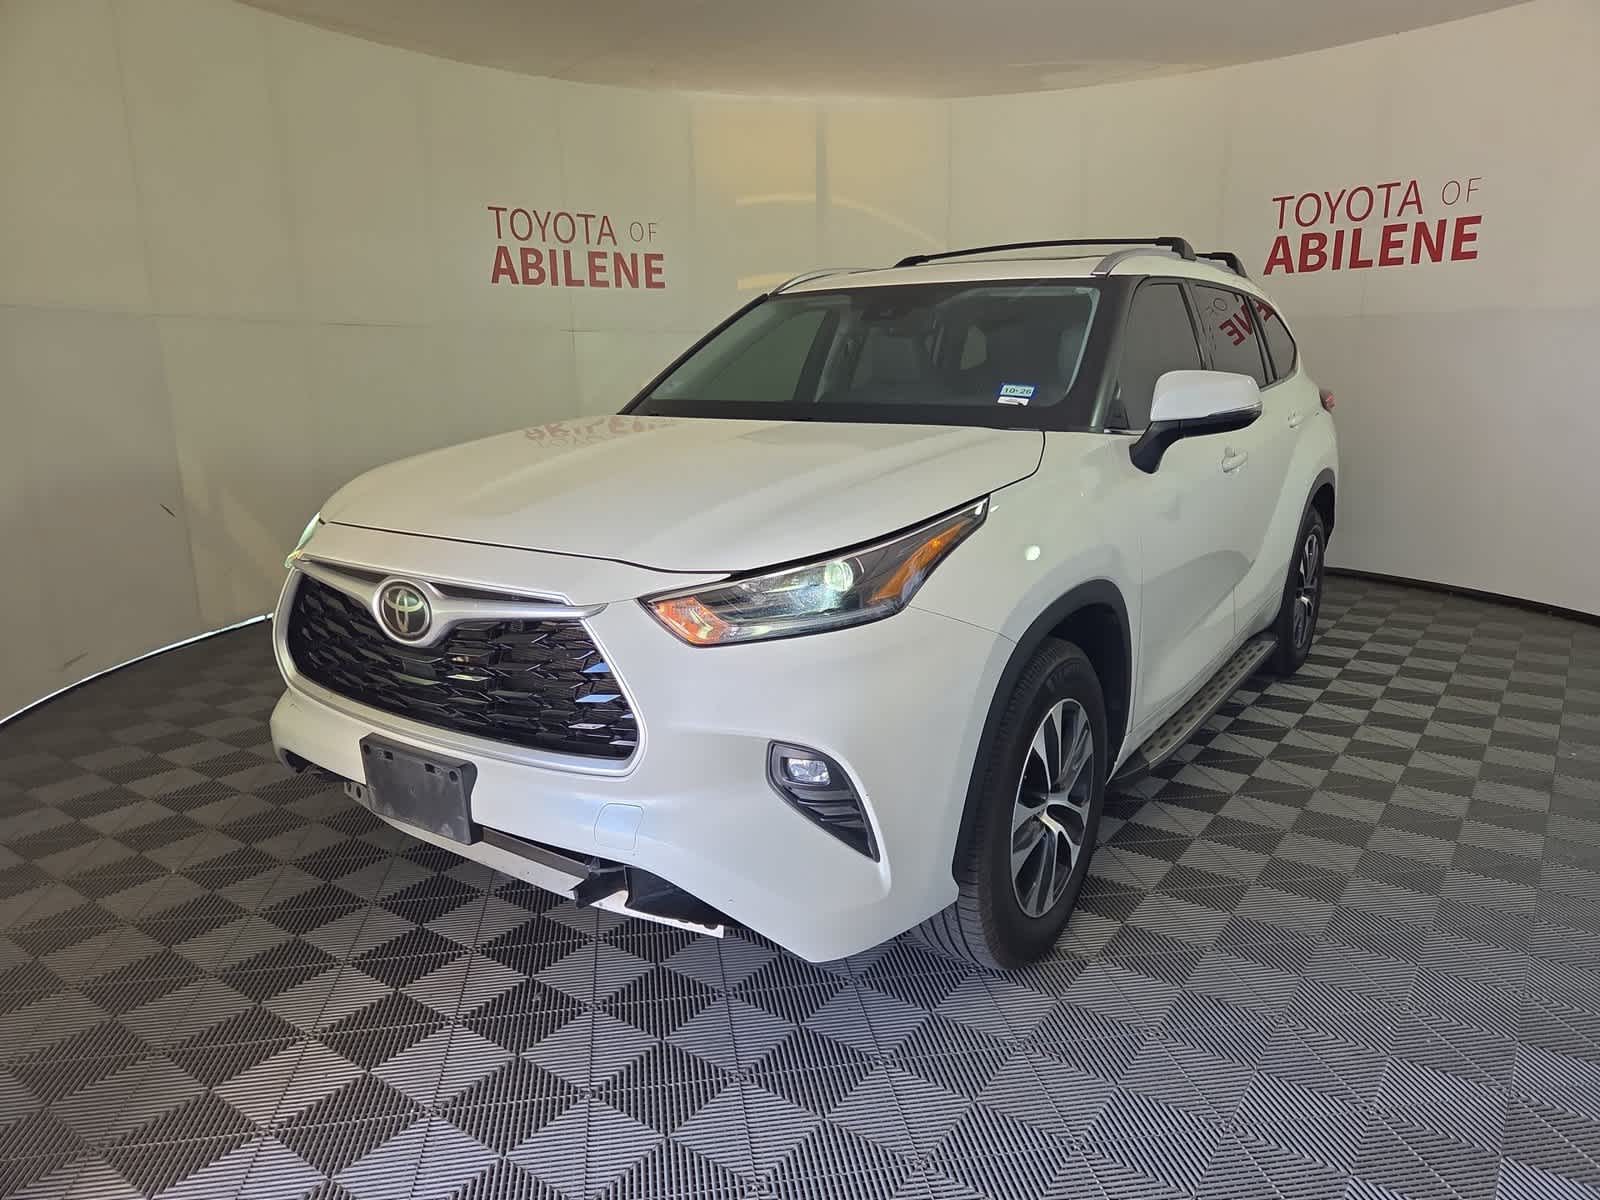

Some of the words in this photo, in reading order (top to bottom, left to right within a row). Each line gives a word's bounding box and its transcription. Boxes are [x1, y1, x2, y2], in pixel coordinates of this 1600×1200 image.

[487, 206, 618, 246] TOYOTA
[629, 221, 658, 243] OF
[1272, 179, 1424, 230] TOYOTA
[1441, 177, 1482, 206] OF
[491, 245, 666, 289] ABILENE
[1263, 215, 1483, 276] ABILENE
